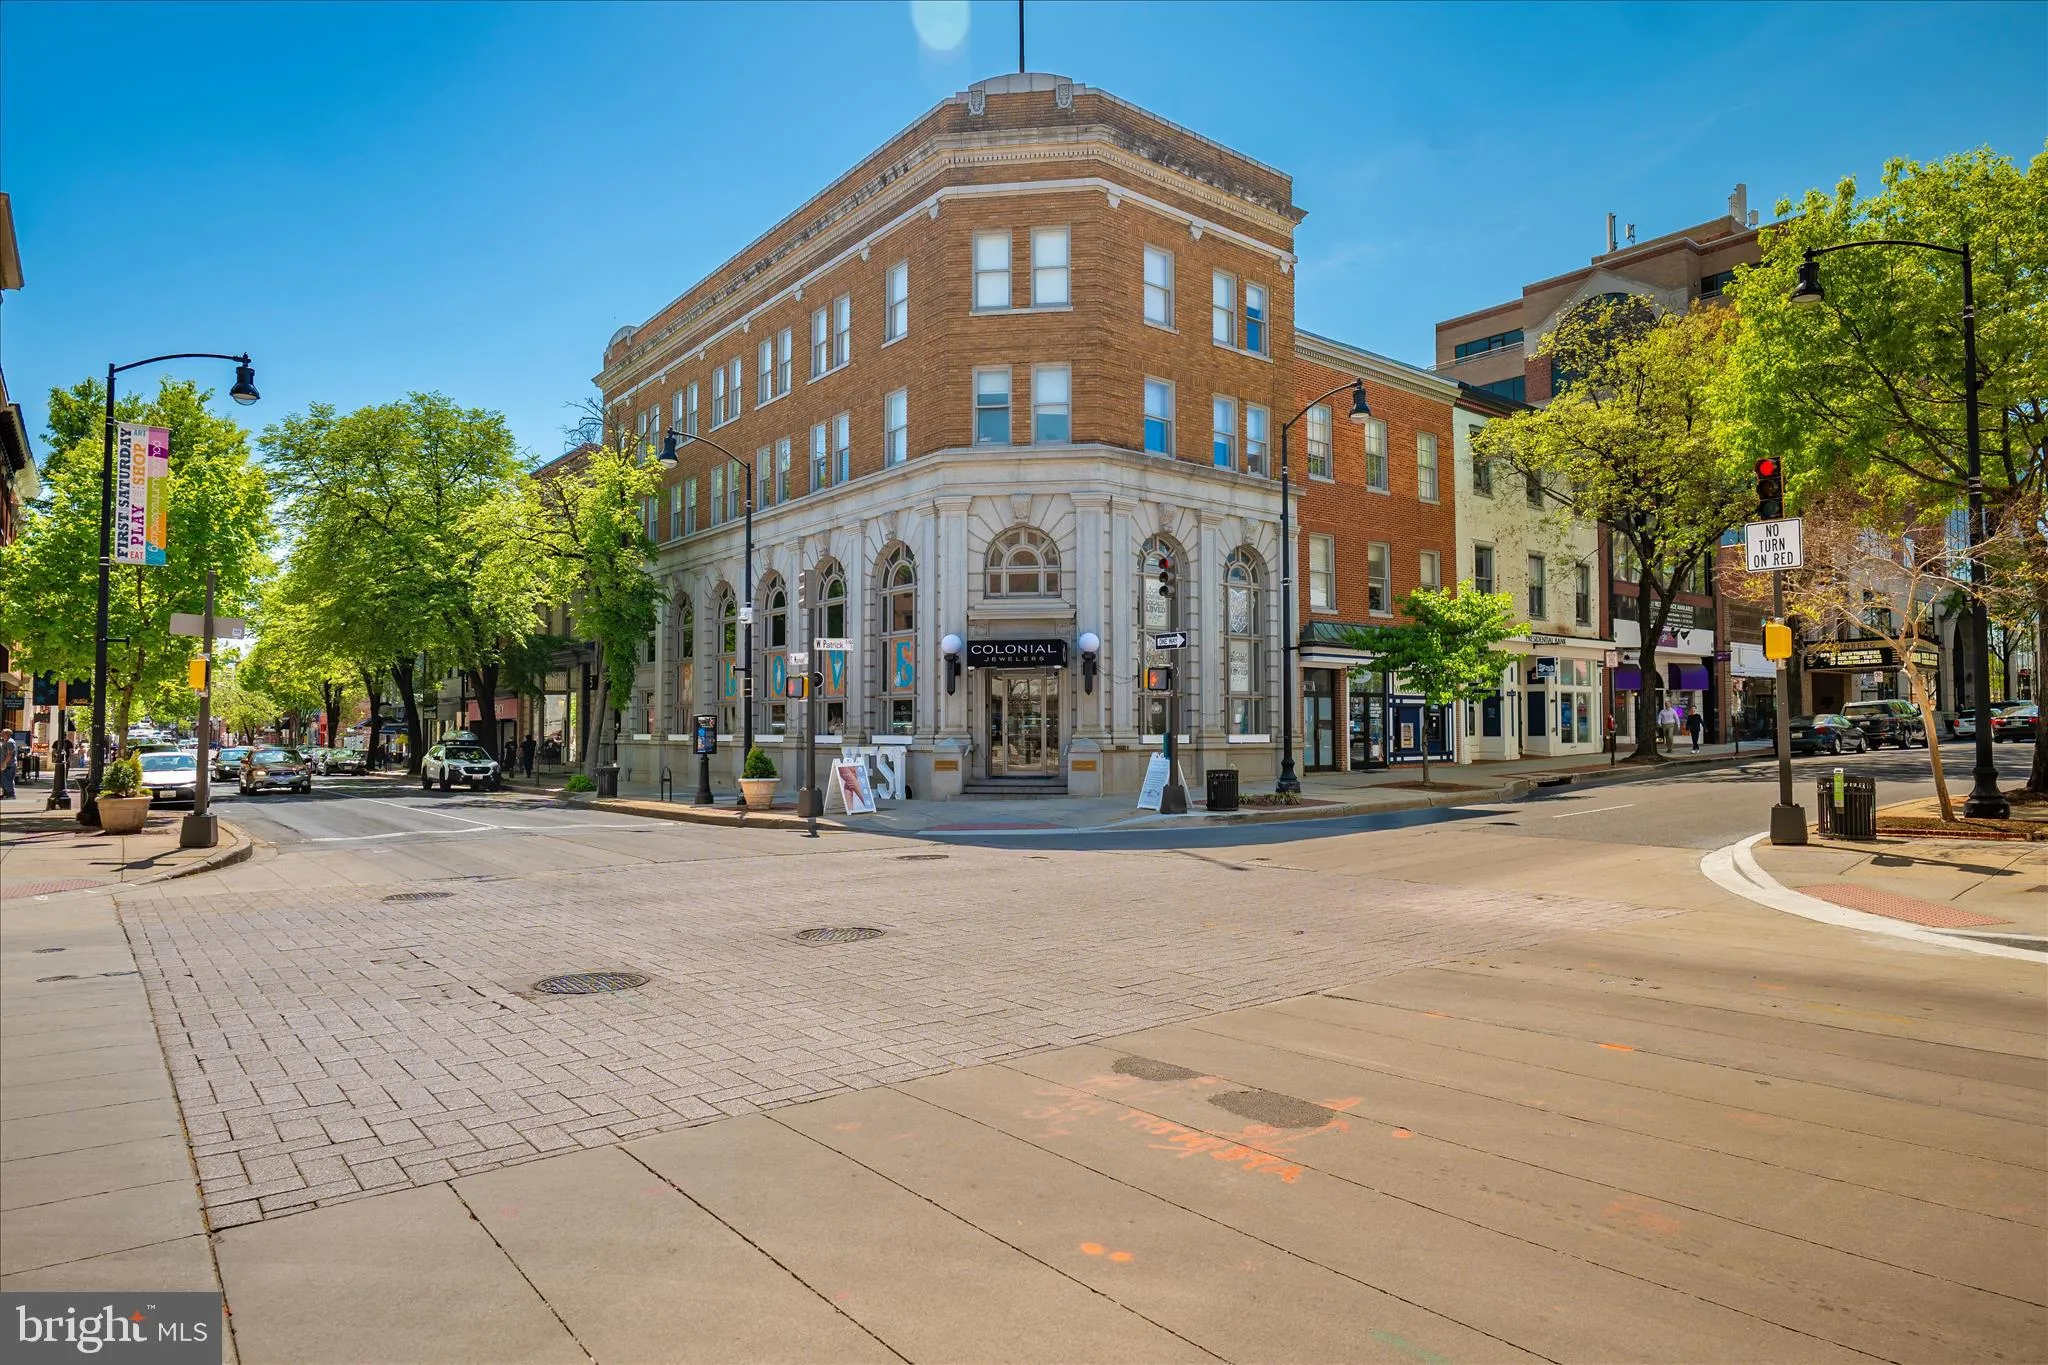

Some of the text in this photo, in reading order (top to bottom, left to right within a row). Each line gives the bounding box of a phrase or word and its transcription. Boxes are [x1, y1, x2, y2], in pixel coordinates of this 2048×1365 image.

[133, 429, 147, 437] ART
[132, 443, 146, 485] SHOP
[117, 427, 132, 558] FIRST SATURDAY
[130, 504, 145, 546] PLAY
[1765, 523, 1779, 537] NO
[1758, 537, 1785, 553] TURN
[130, 550, 144, 560] EAT
[1753, 551, 1794, 568] ON RED
[1146, 606, 1166, 614] LOVED
[815, 640, 821, 648] W
[823, 640, 844, 649] Patrick
[1168, 637, 1178, 645] WAY
[1526, 635, 1554, 644] PRESIDENTIAL
[971, 644, 1057, 655] COLONIAL
